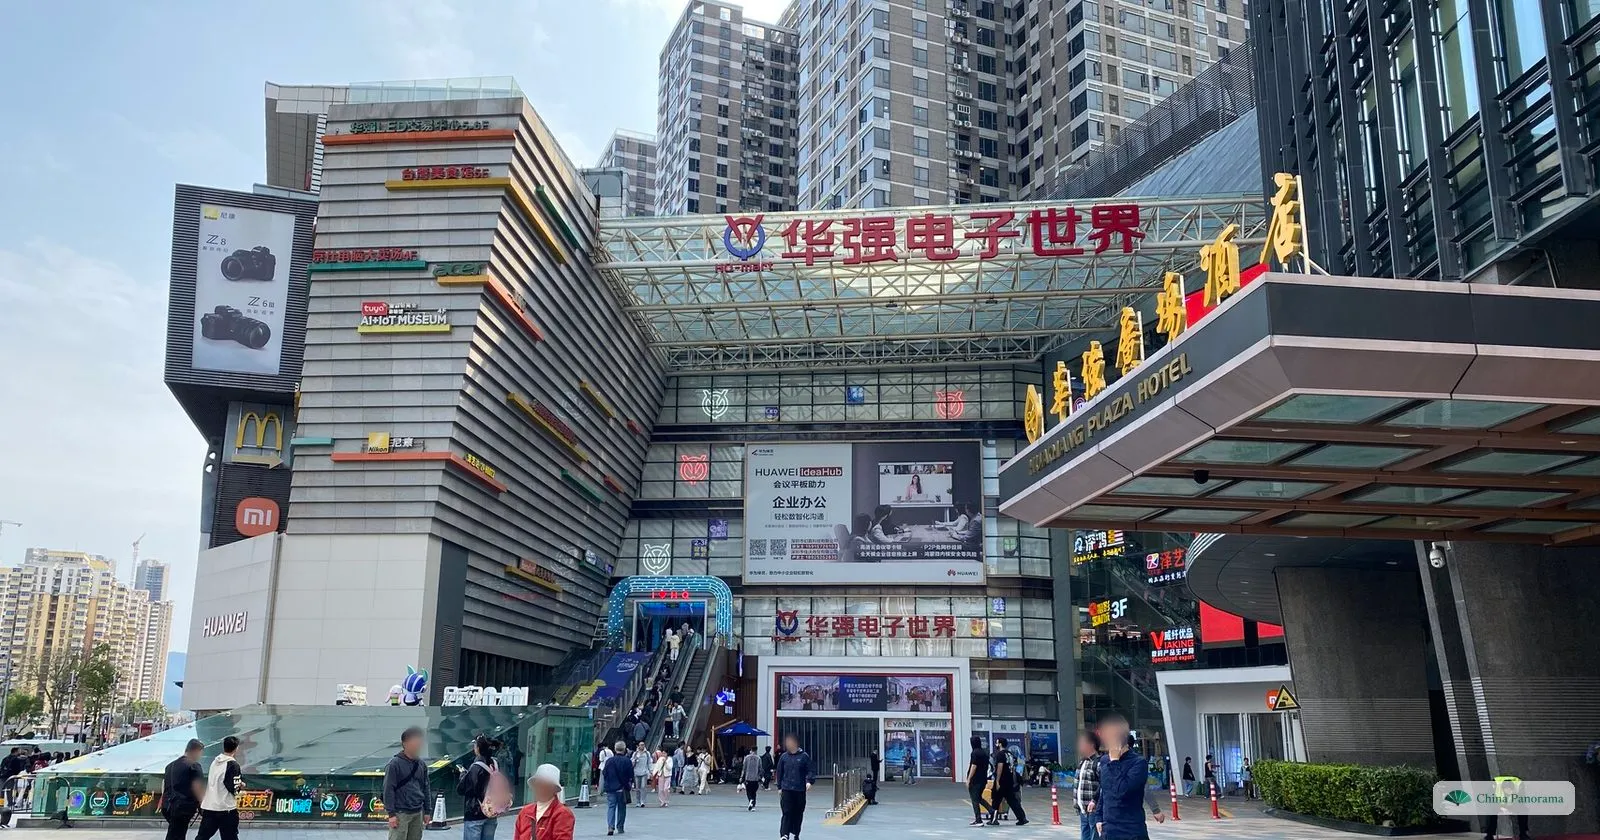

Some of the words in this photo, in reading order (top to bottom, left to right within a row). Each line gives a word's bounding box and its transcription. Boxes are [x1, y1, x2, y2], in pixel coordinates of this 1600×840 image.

[782, 204, 1146, 266] 华强电子世界
[433, 263, 483, 276] acer
[364, 305, 385, 313] tuya
[360, 315, 396, 326] AI+IoT
[397, 314, 447, 326] MUSEUM
[1086, 391, 1135, 438] PLAZA
[1137, 352, 1194, 404] HOTEL
[755, 468, 798, 477] HUAWEI
[800, 467, 842, 476] IdeaHub
[773, 480, 826, 489] 会议平板助力
[772, 496, 827, 509] 企业办公
[1111, 598, 1128, 619] 3F
[203, 611, 249, 638] HUAWEI
[805, 615, 957, 639] 华强电子世界
